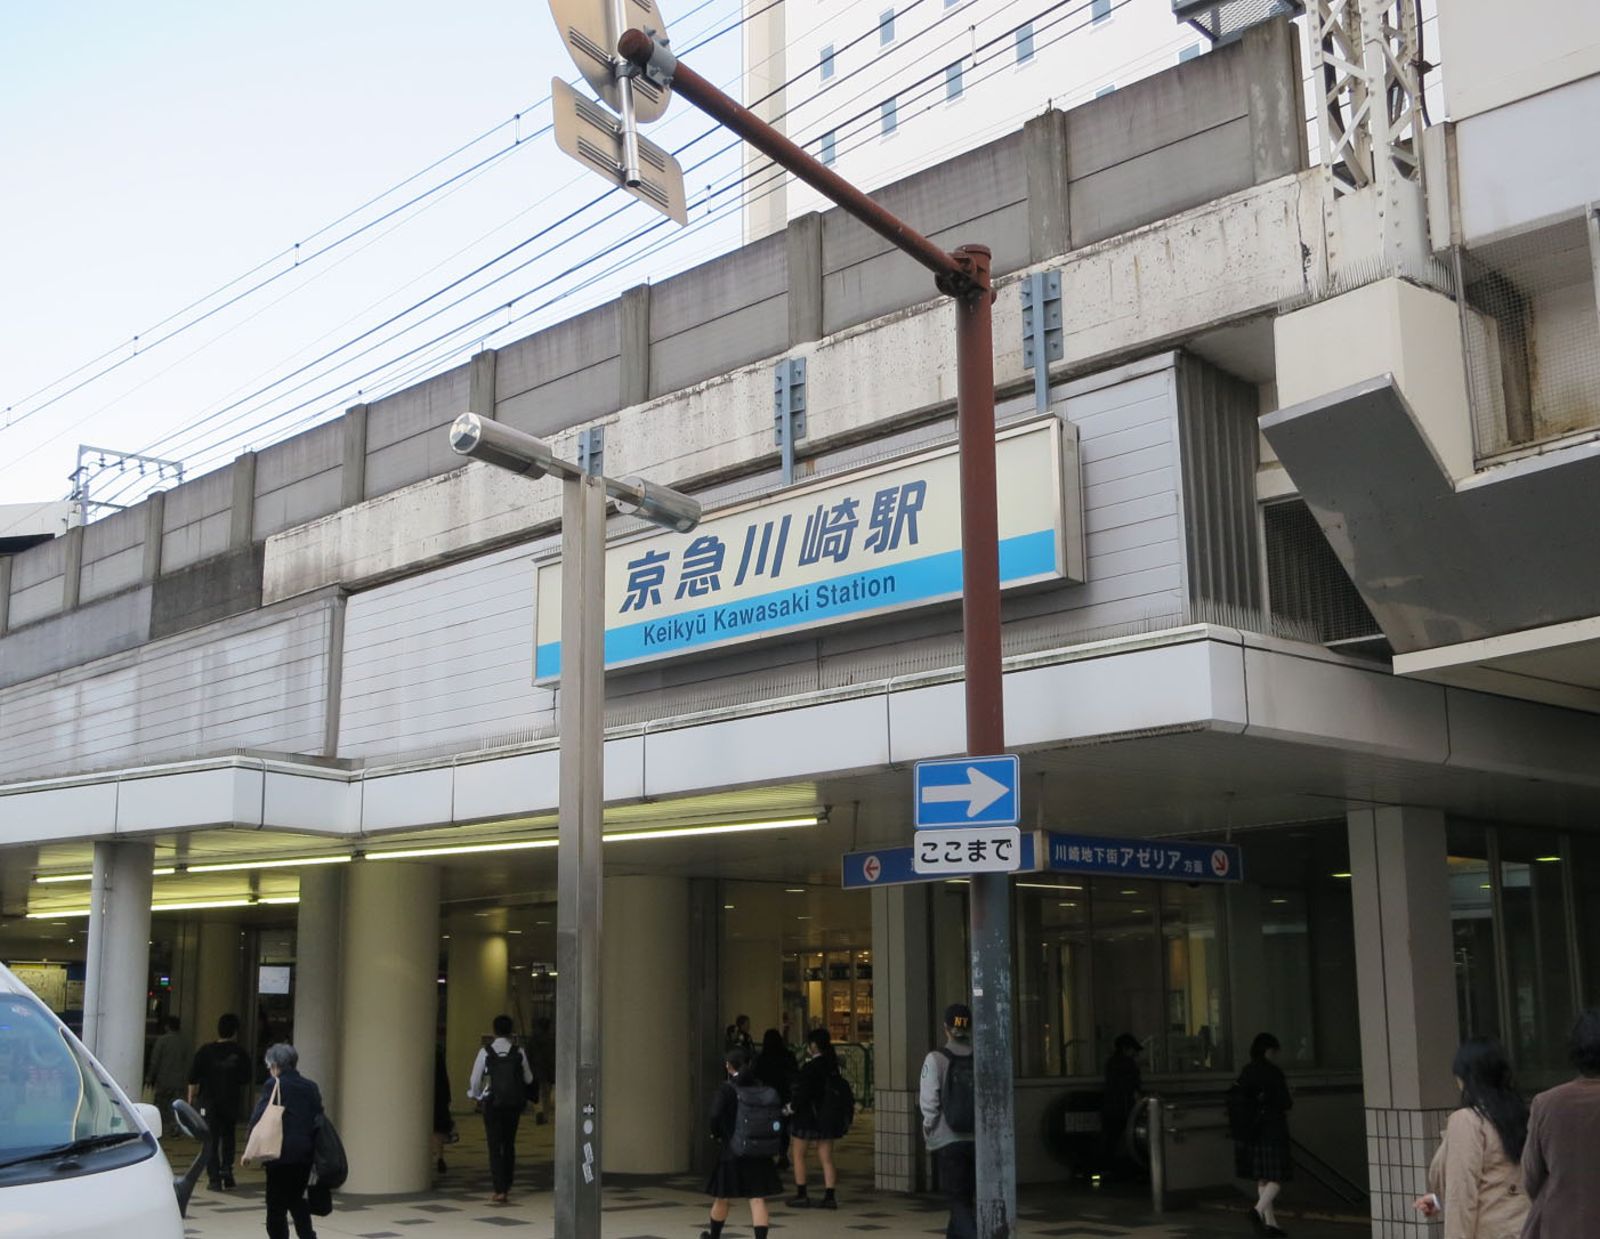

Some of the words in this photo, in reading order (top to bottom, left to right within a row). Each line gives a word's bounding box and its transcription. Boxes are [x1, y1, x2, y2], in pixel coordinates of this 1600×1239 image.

[618, 480, 927, 613] 京急川崎駅
[644, 614, 706, 646] Keikyū
[714, 589, 809, 631] Kawasaki
[816, 575, 895, 608] Station
[921, 839, 1012, 863] ここまで
